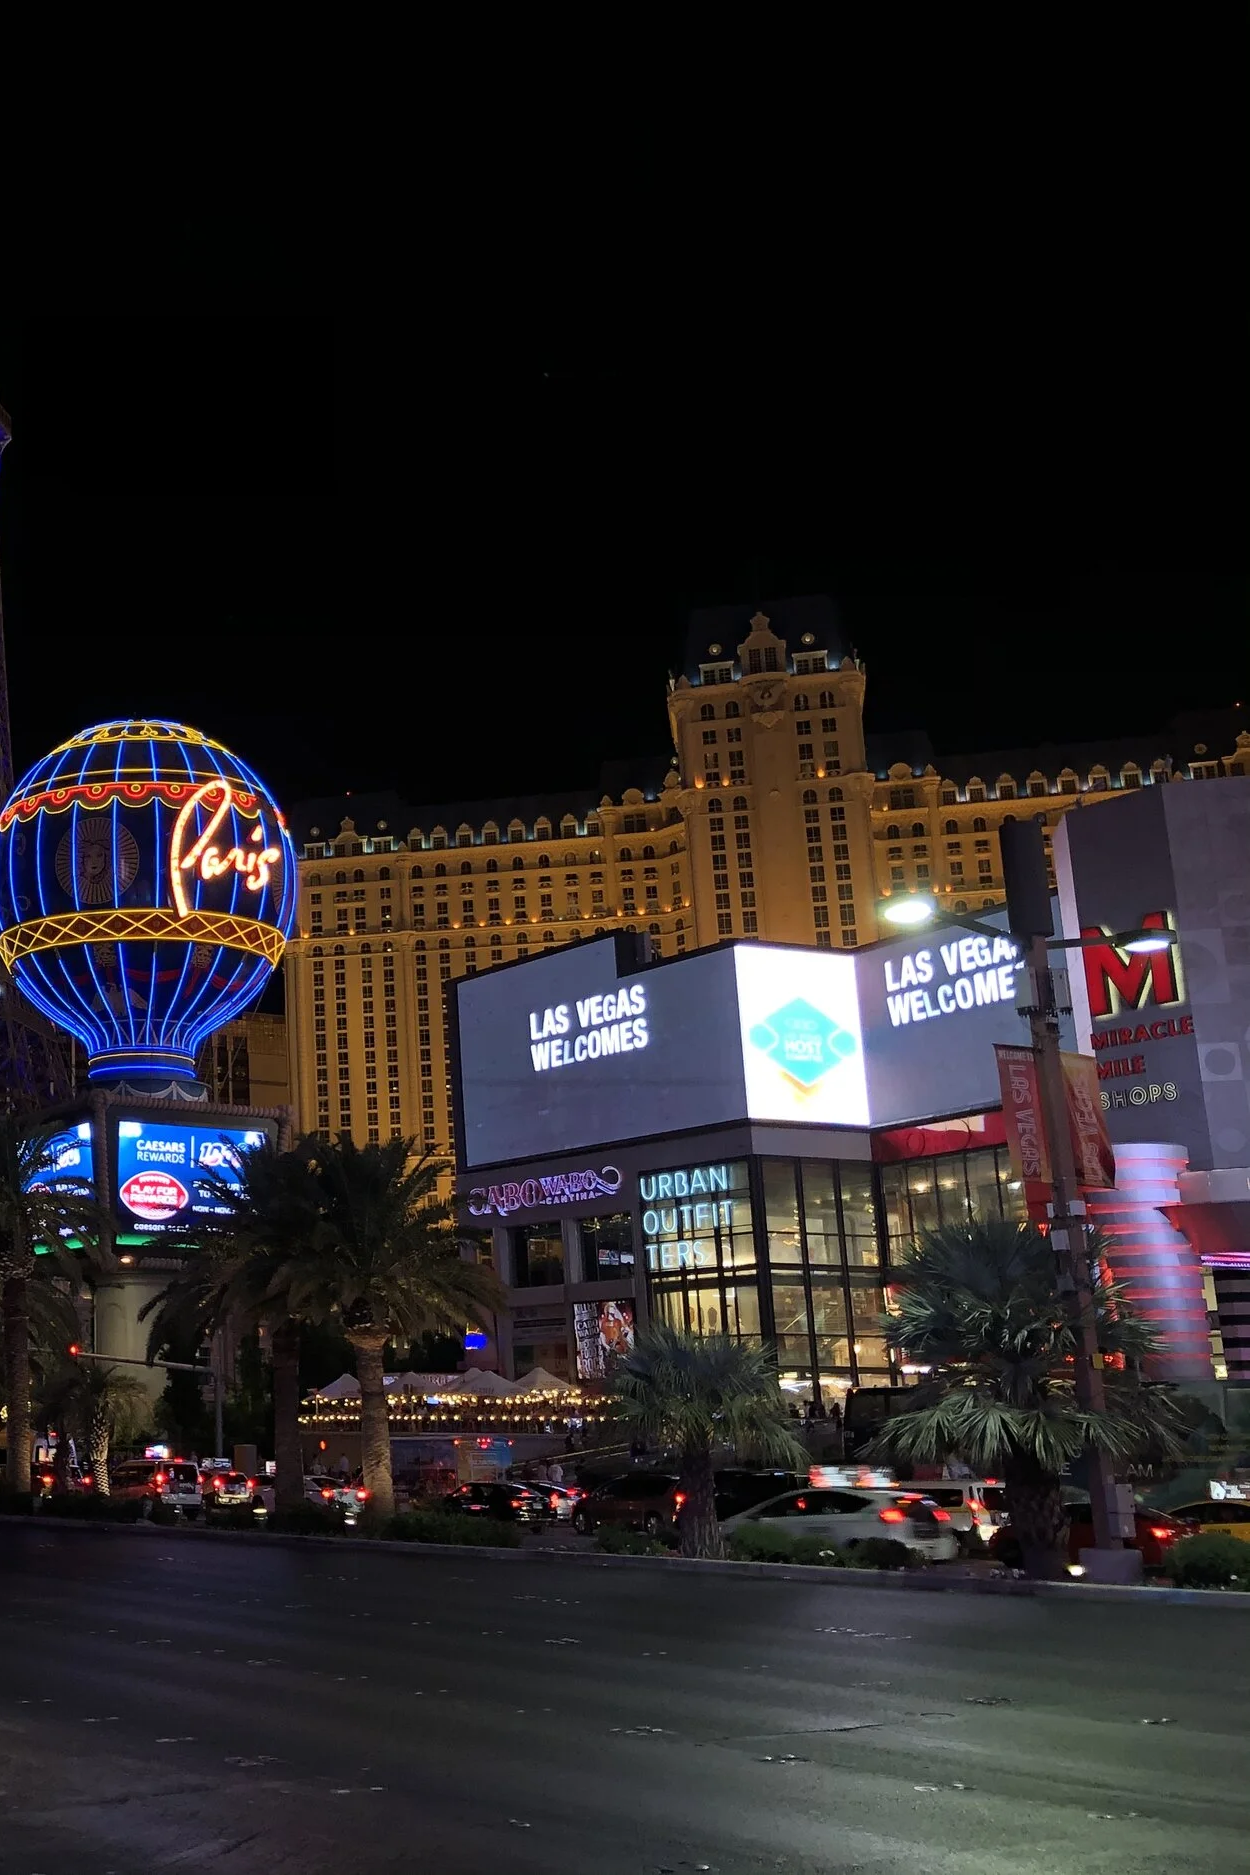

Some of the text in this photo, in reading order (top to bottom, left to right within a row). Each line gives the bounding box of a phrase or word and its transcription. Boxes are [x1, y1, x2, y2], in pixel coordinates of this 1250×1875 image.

[171, 779, 281, 919] Paris
[883, 935, 1019, 993] LAS VEGA
[529, 983, 647, 1041] LAS VEGAS
[886, 959, 1026, 1028] WELCOME
[530, 1017, 650, 1073] WELCOMES
[1090, 1015, 1195, 1051] MIRACLE
[1097, 1055, 1147, 1081] MILE
[1099, 1081, 1178, 1111] SHOPS
[1008, 1064, 1041, 1177] LAS VEGAS
[136, 1139, 186, 1154] CAESARS
[136, 1151, 186, 1164] REWARDS
[130, 1184, 178, 1197] PLAY FOR
[468, 1169, 598, 1217] CABO WABO
[545, 1190, 596, 1205] CANTINA
[639, 1164, 728, 1201] URBAN
[643, 1199, 733, 1236] OUTFIT
[646, 1240, 708, 1270] TERS
